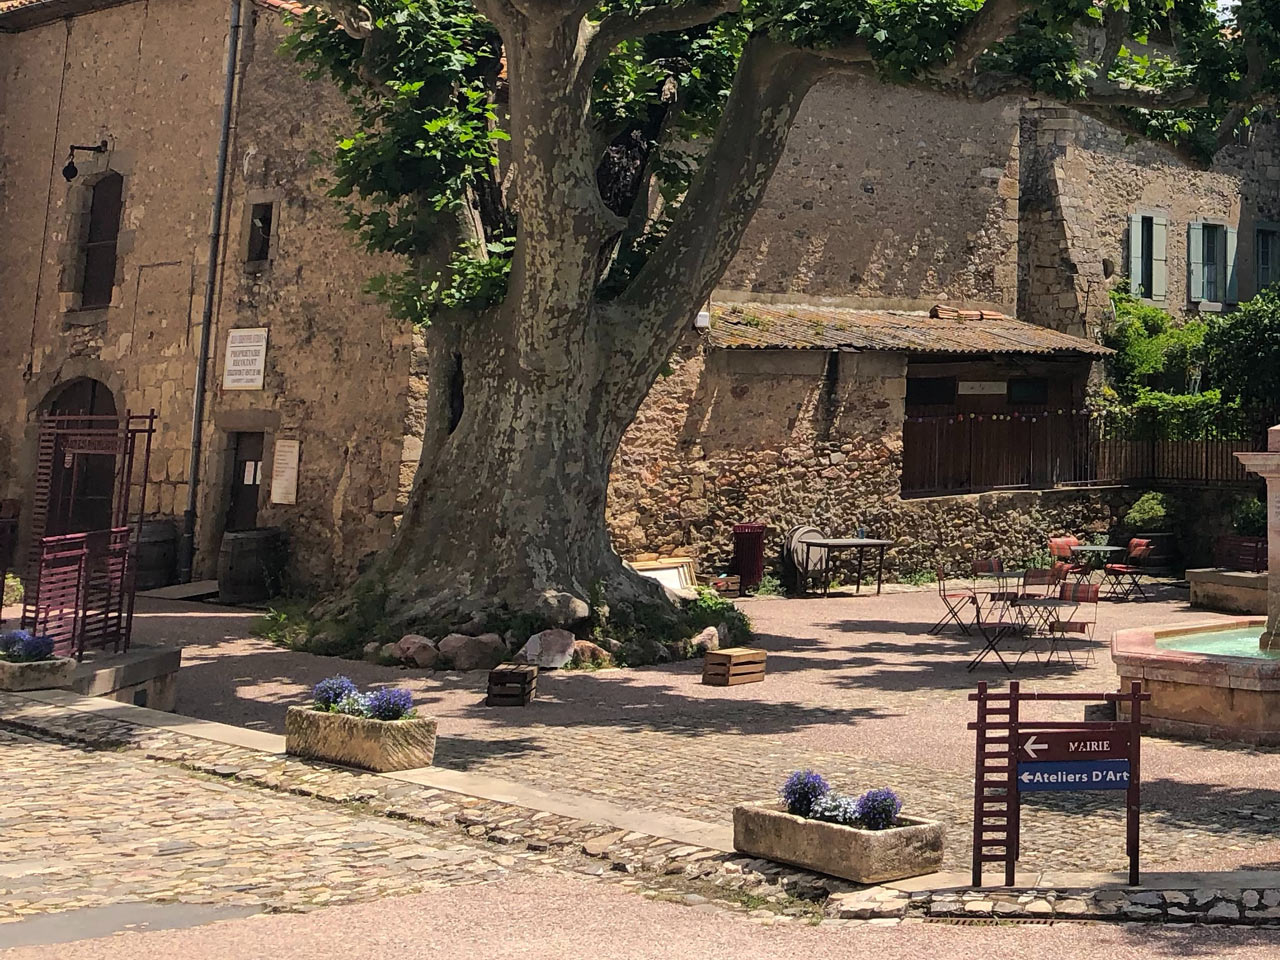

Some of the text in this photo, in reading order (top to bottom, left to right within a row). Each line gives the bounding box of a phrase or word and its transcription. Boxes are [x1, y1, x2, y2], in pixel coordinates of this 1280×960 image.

[1069, 741, 1110, 751] MAIRIE
[1034, 770, 1131, 783] Ateliers D'Art
